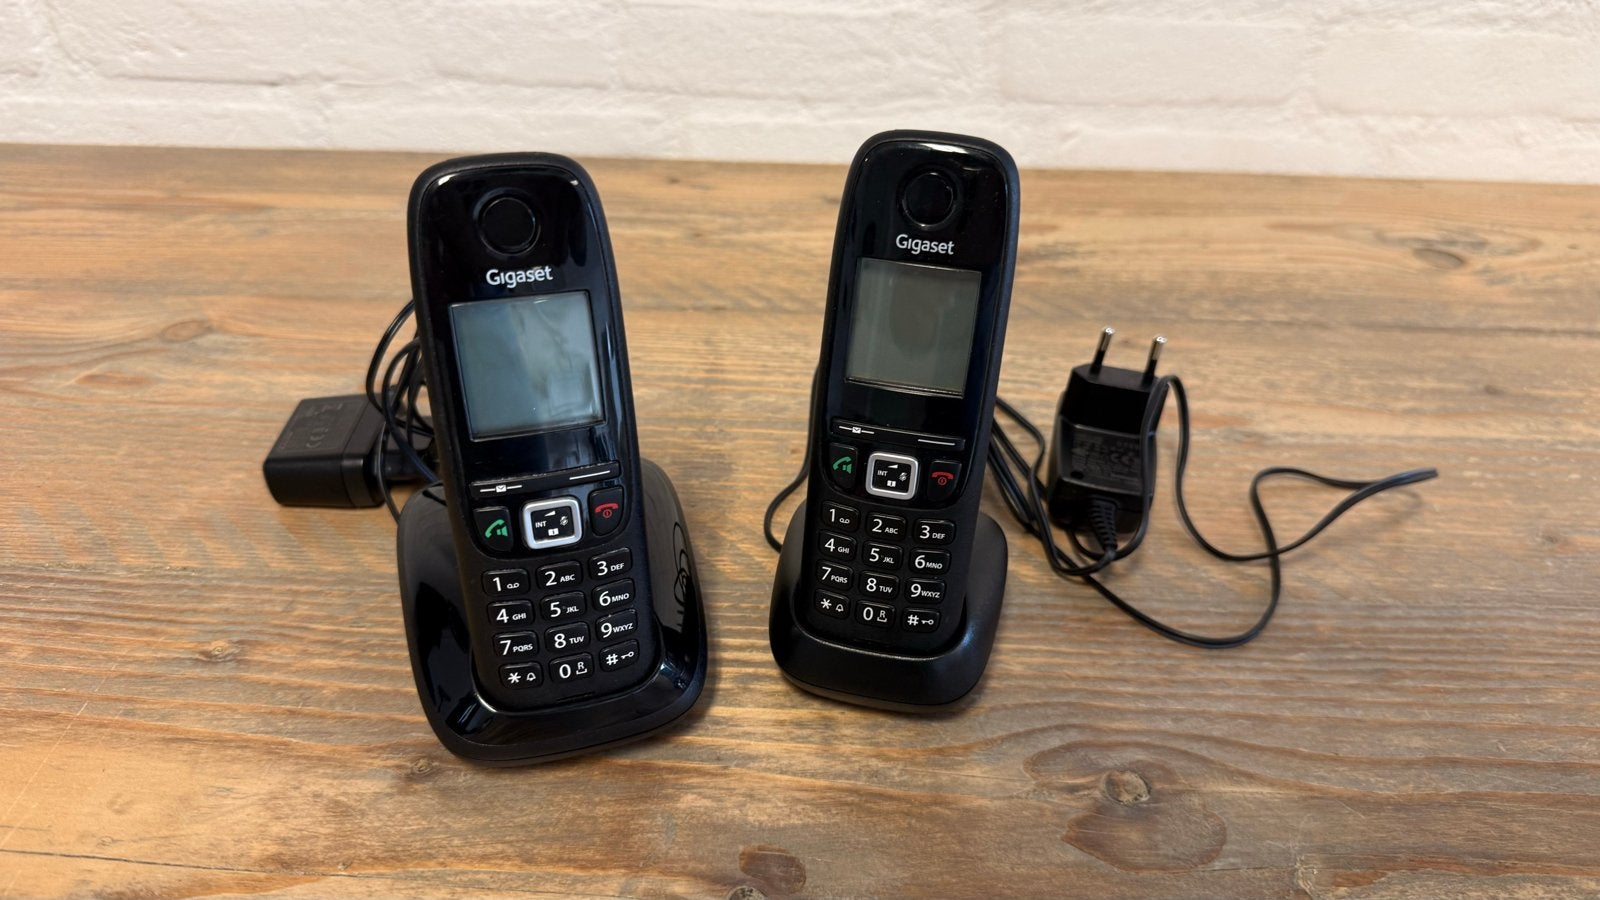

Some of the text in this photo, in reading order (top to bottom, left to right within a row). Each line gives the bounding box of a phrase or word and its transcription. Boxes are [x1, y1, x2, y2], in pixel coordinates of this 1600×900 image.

[895, 234, 954, 255] Gigaset
[486, 265, 553, 288] Gigaset
[829, 508, 836, 522] 1
[535, 520, 547, 528] INT
[872, 518, 883, 533] 2
[919, 525, 931, 539] 3
[825, 538, 836, 552] 4
[869, 548, 880, 562] 5
[915, 555, 943, 570] 6 MNO
[597, 561, 625, 576] 3 DEF
[821, 566, 848, 584] 7 PQRS
[492, 577, 501, 592] 1
[544, 571, 576, 586] 2 ABC
[866, 578, 893, 593] 8 TUV
[910, 583, 941, 598] 9 WXYZ
[599, 591, 630, 607] 6 MNO
[496, 608, 527, 623] 4 GHI
[550, 601, 579, 617] 5 JKL
[863, 607, 874, 621] 0
[601, 622, 634, 638] 9 WXYZ
[500, 639, 533, 655] 7 PQRS
[554, 633, 585, 648] 8 TUV
[559, 664, 571, 678] 0
